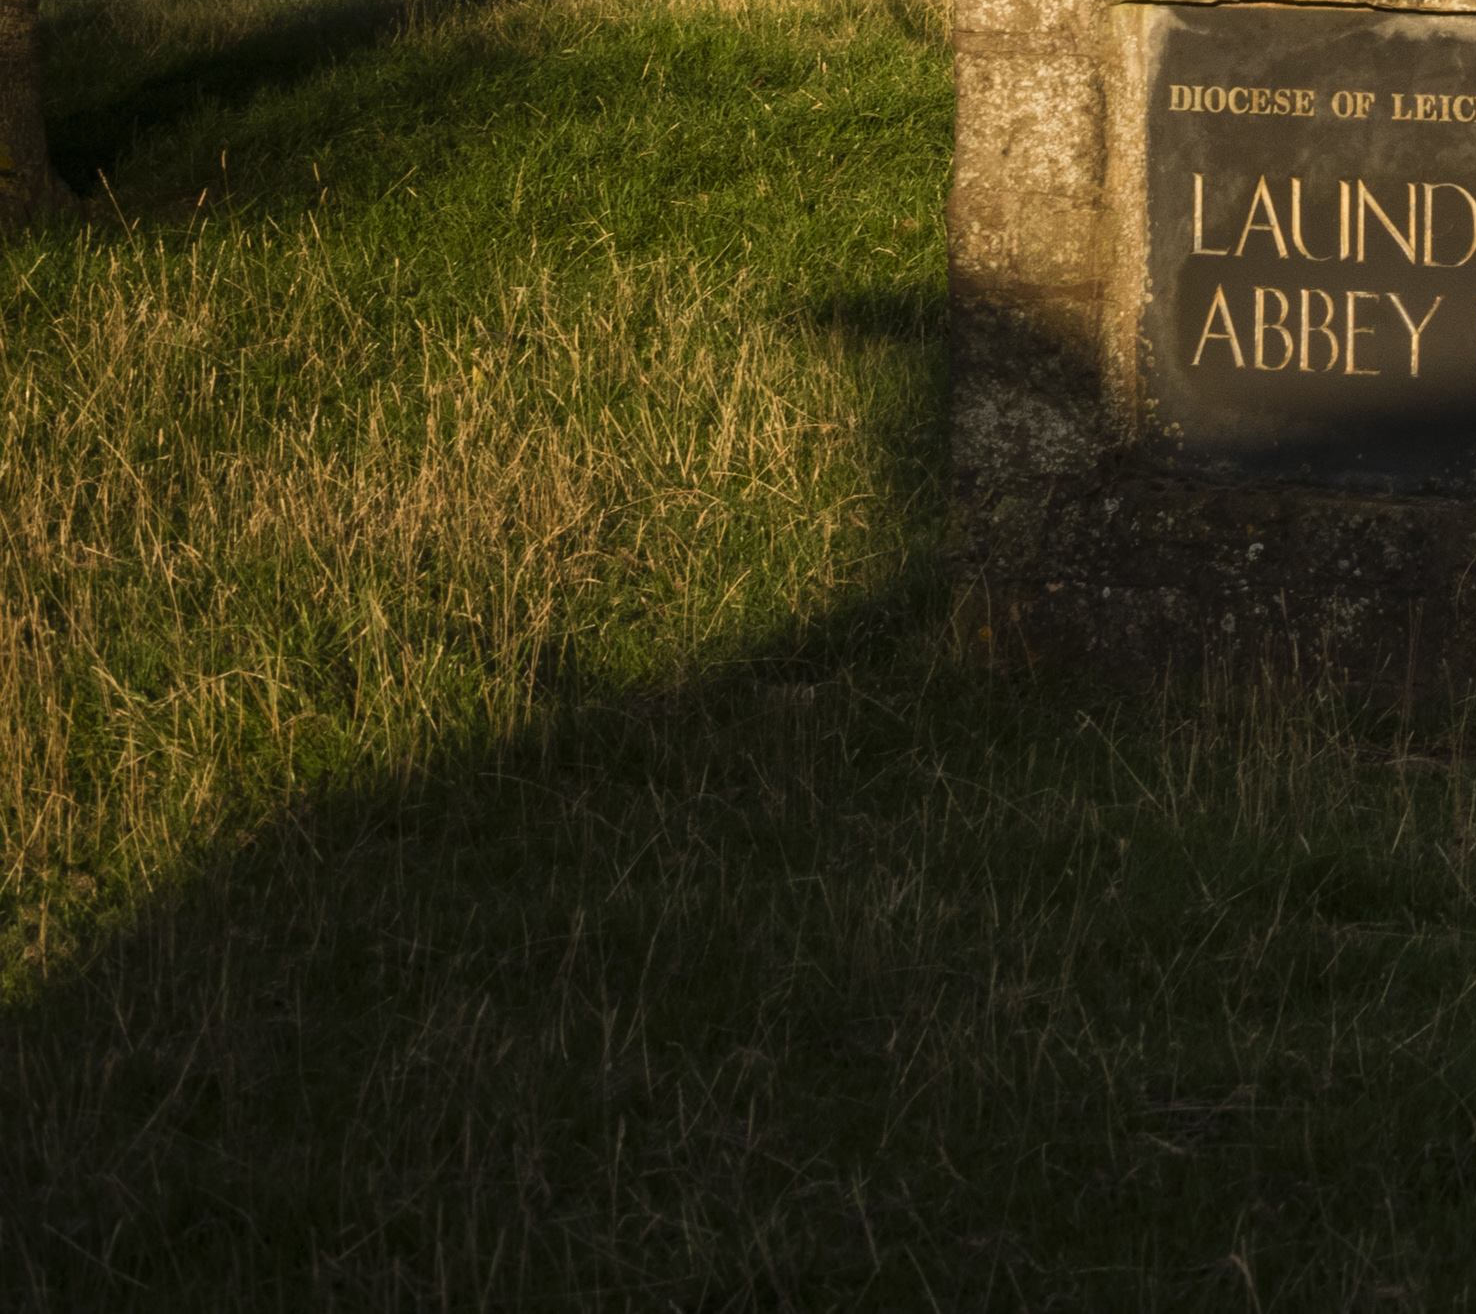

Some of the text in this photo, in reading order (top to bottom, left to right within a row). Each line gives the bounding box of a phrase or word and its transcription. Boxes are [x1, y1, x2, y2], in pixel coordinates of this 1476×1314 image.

[1169, 85, 1315, 117] DIOCESE
[1331, 90, 1376, 119] OF
[1191, 283, 1444, 378] ABBEY
